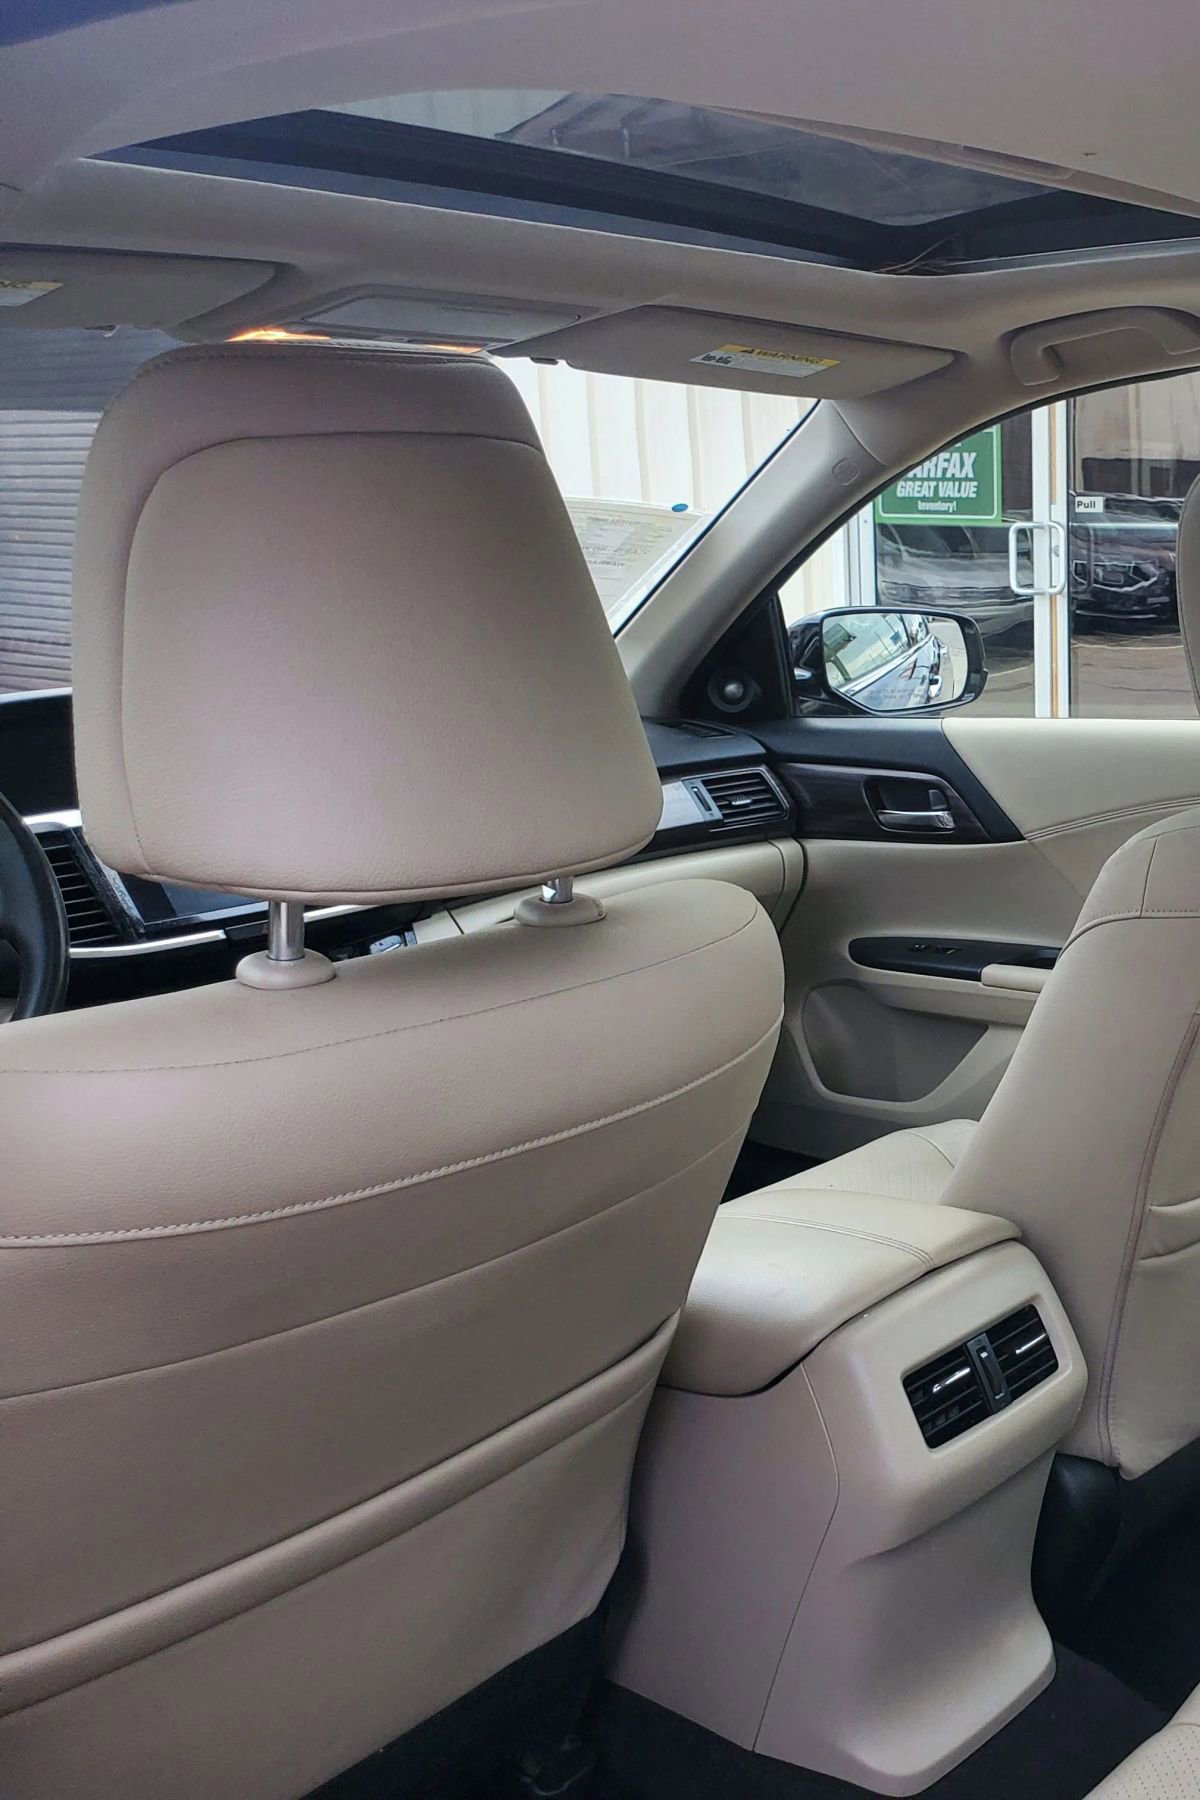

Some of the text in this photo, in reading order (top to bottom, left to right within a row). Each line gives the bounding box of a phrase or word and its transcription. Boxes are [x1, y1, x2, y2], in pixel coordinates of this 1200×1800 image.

[907, 452, 976, 478] ARFAX
[896, 481, 977, 498] GREAT VALUE
[1077, 500, 1096, 509] Pull
